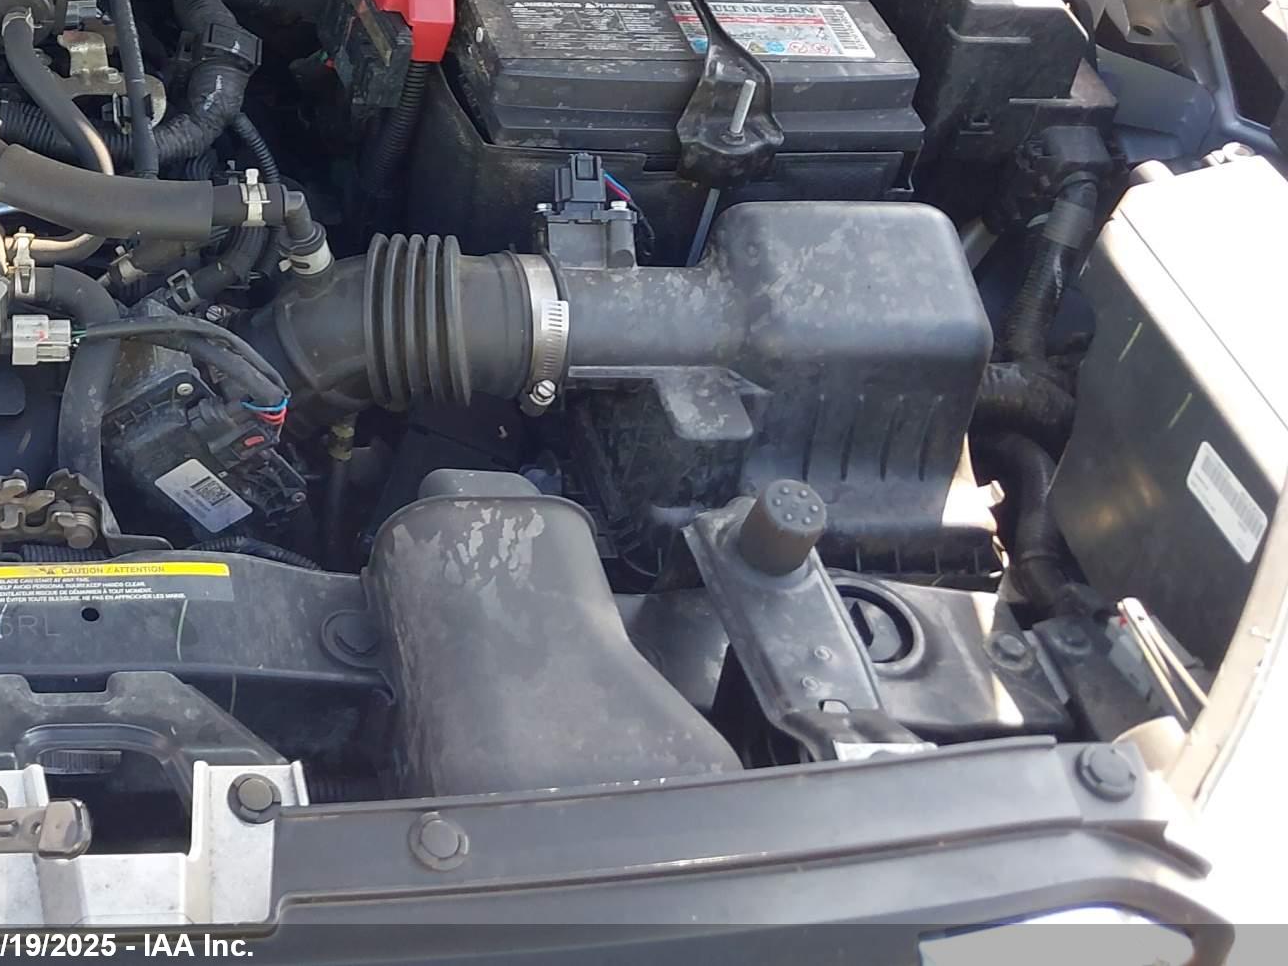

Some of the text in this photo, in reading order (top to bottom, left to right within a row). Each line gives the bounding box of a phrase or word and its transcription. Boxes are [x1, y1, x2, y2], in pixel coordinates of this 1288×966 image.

[742, 4, 816, 14] NISSAN
[61, 566, 104, 575] CAUTION
[114, 565, 166, 574] ATTENTION
